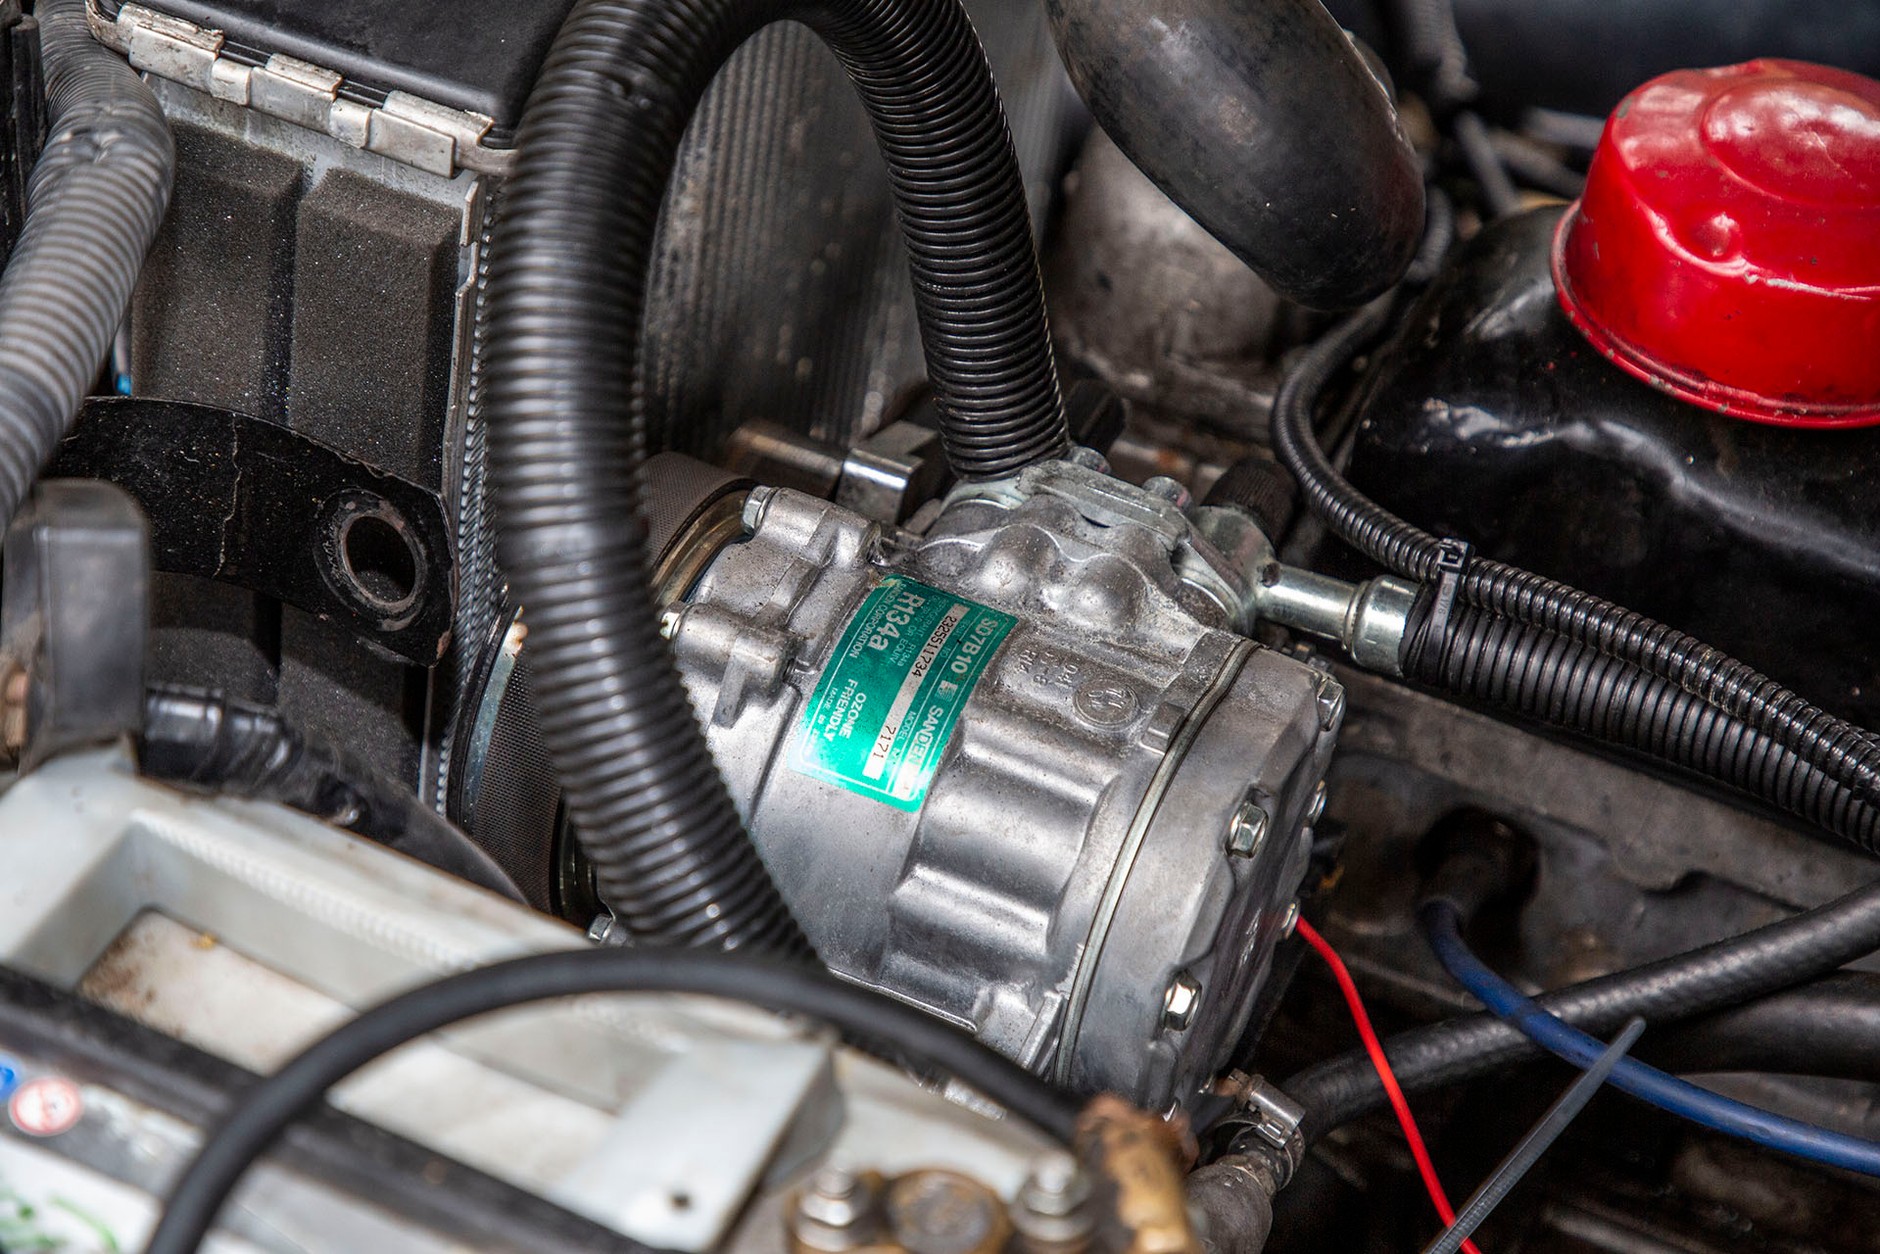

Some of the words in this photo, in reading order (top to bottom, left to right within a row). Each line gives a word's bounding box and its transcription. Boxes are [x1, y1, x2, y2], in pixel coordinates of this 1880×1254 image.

[848, 604, 888, 658] CORPORATION
[866, 591, 925, 653] R134a
[904, 624, 917, 636] OR
[910, 615, 957, 677] 2325511734
[948, 616, 999, 675] SD7B10
[896, 643, 916, 667] R134a
[822, 678, 858, 741] FRIENDLY
[823, 687, 838, 710] MADE
[837, 691, 867, 739] OZONE
[872, 724, 896, 759] 7171
[896, 710, 916, 742] MODEL
[907, 704, 944, 766] SANDEN
